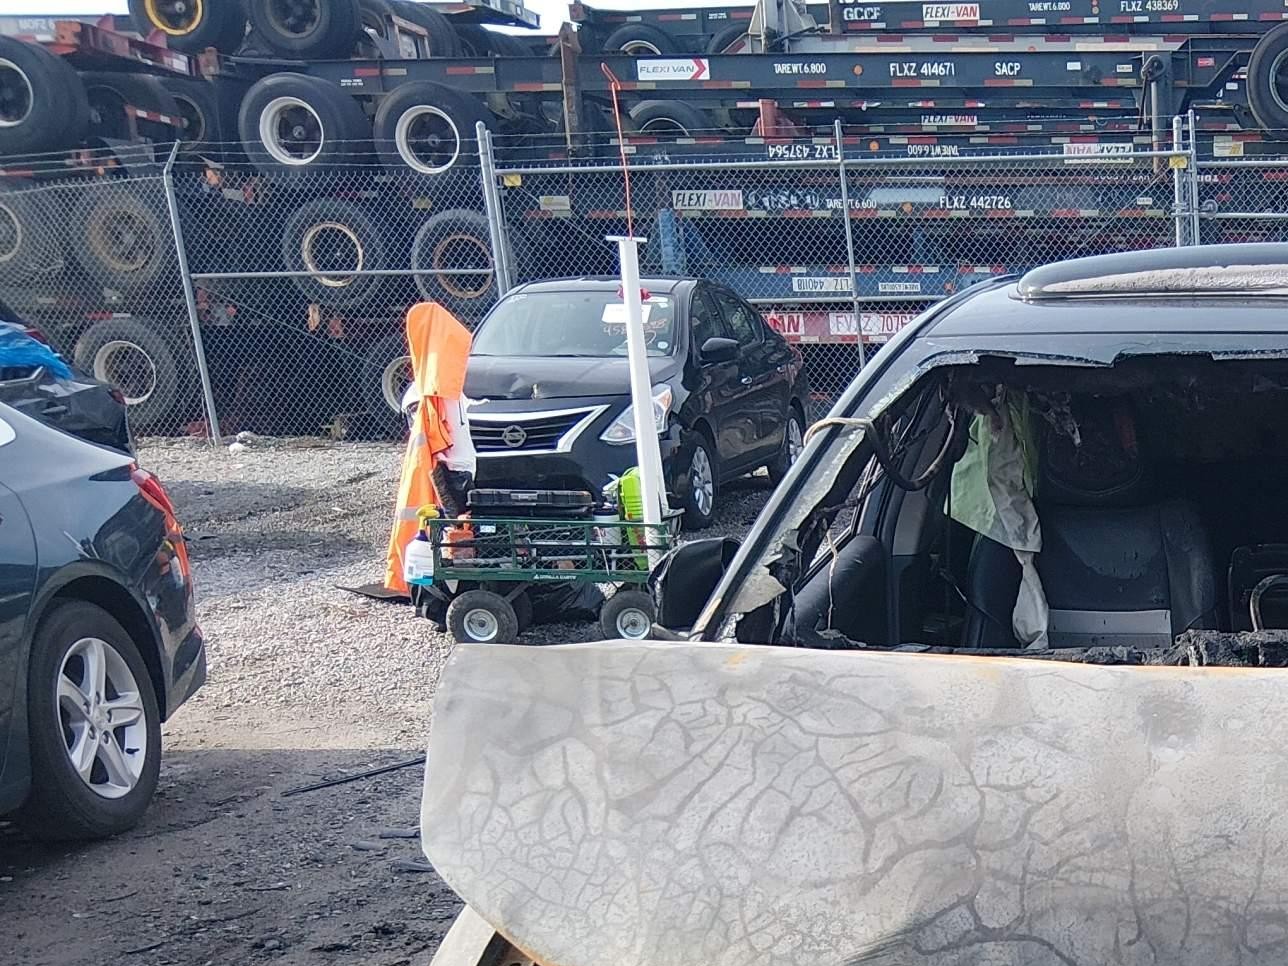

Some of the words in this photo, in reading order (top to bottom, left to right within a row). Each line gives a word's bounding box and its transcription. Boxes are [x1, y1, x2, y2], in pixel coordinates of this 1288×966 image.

[924, 5, 978, 18] FLEXI-VAN
[1120, 1, 1142, 12] FLXZ
[1145, 0, 1179, 11] 438369
[639, 65, 670, 74] FLEXI
[671, 65, 695, 74] VAN
[889, 62, 917, 77] FLXZ
[920, 62, 955, 76] 414671
[994, 62, 1021, 76] SACP
[768, 145, 809, 158] 437564
[814, 145, 841, 158] FLXZ
[674, 192, 742, 208] FLEXI-VAN
[939, 196, 967, 209] FLXZ
[970, 196, 1012, 209] 442726
[836, 315, 875, 333] FVZ
